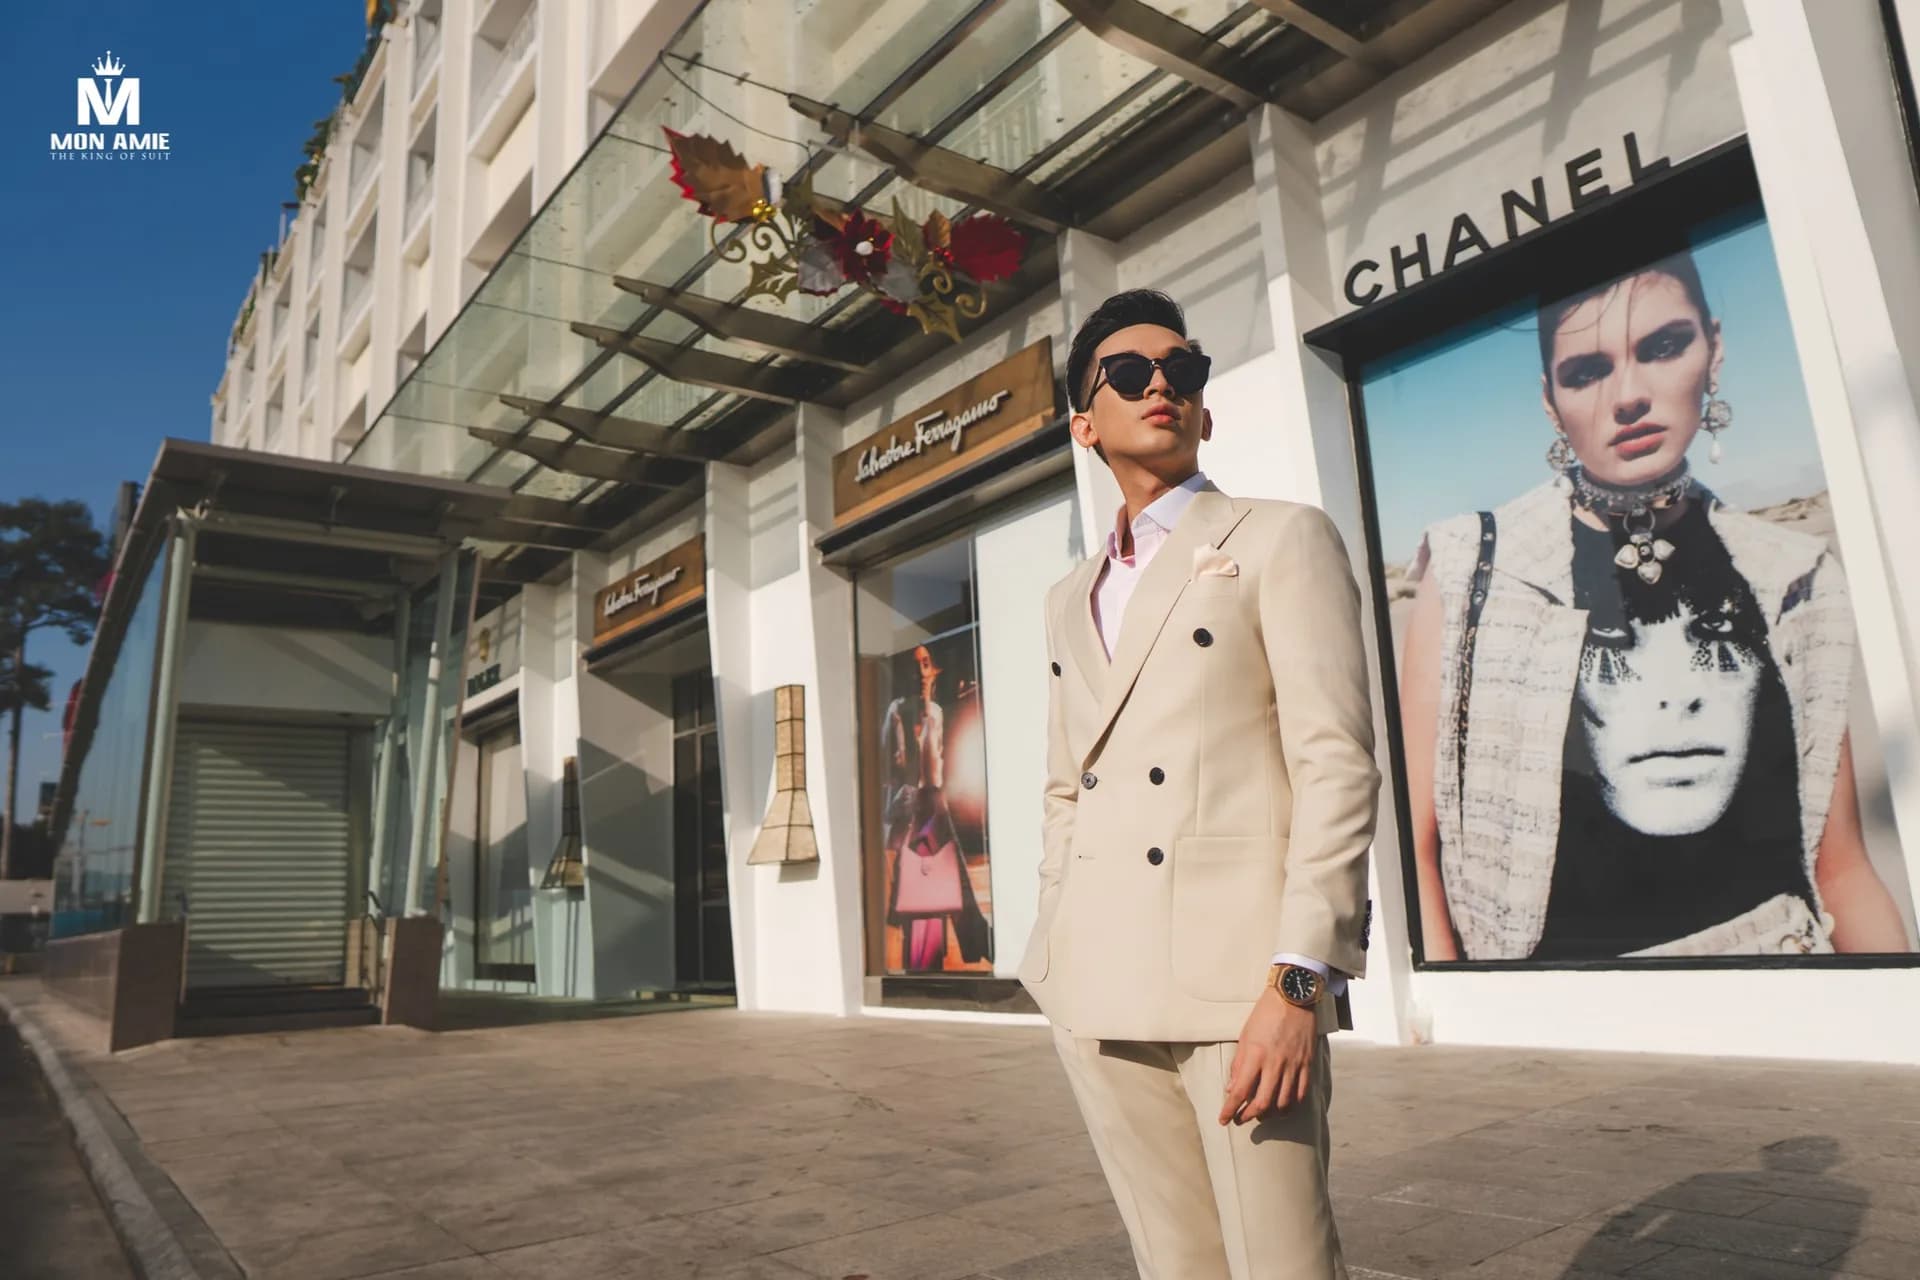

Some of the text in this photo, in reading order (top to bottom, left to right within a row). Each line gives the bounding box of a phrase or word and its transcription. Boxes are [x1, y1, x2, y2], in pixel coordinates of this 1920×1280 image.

[1343, 132, 1671, 306] CHANEL
[855, 389, 1009, 482] Salvatore Ferragamo
